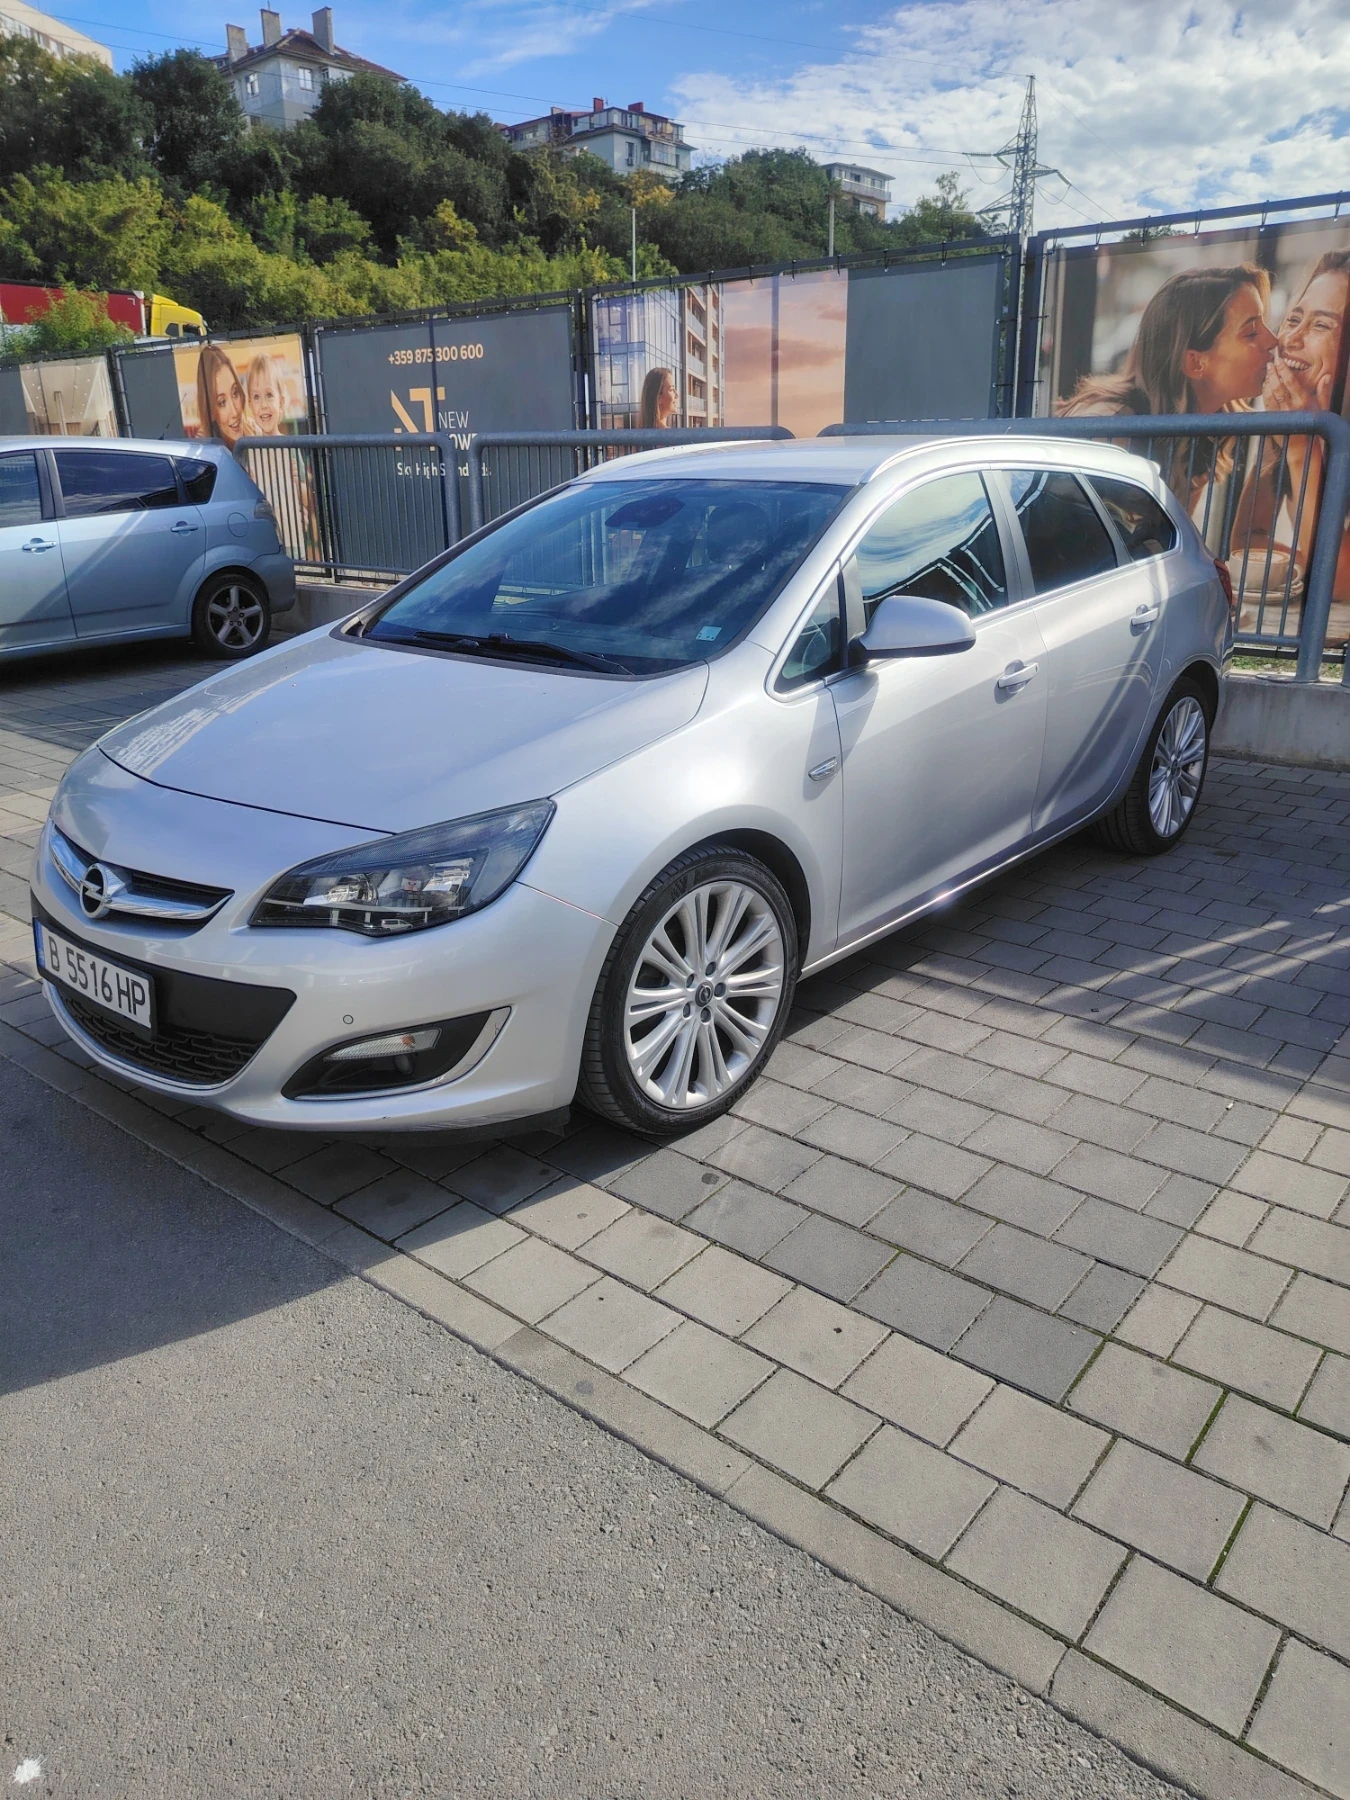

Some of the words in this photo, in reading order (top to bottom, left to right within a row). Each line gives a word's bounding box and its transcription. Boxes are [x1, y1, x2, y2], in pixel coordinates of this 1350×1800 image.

[388, 350, 413, 365] +359
[415, 348, 434, 364] 875
[435, 346, 458, 362] 300
[460, 343, 484, 360] 600
[438, 411, 469, 429] NEW
[48, 935, 61, 972] B
